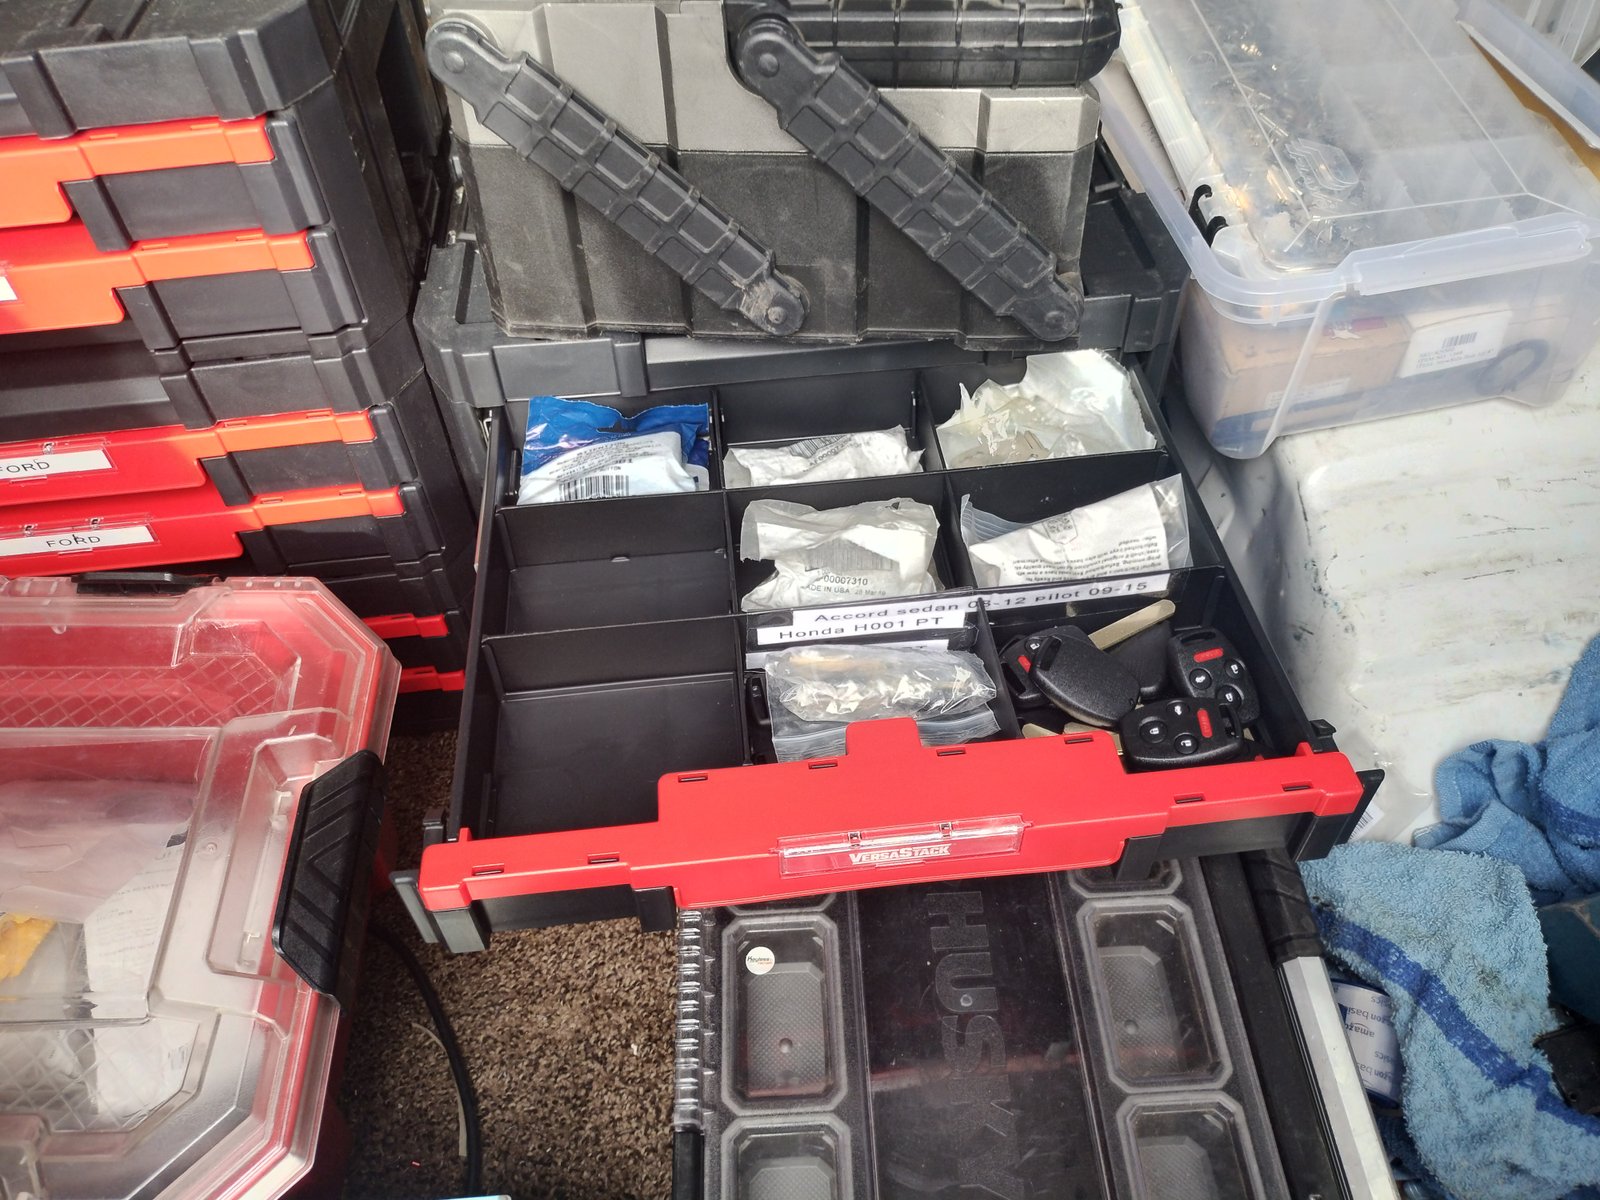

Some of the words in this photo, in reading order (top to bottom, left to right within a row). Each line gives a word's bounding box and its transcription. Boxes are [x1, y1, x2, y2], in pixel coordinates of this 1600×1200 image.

[0, 461, 50, 473] ORD
[46, 535, 101, 548] FORD
[833, 586, 850, 594] USA
[814, 608, 888, 622] Accord
[896, 603, 959, 615] sedan
[1089, 582, 1147, 597] 09-15
[778, 626, 845, 639] Honda
[854, 620, 905, 632] H001
[916, 616, 944, 626] PT
